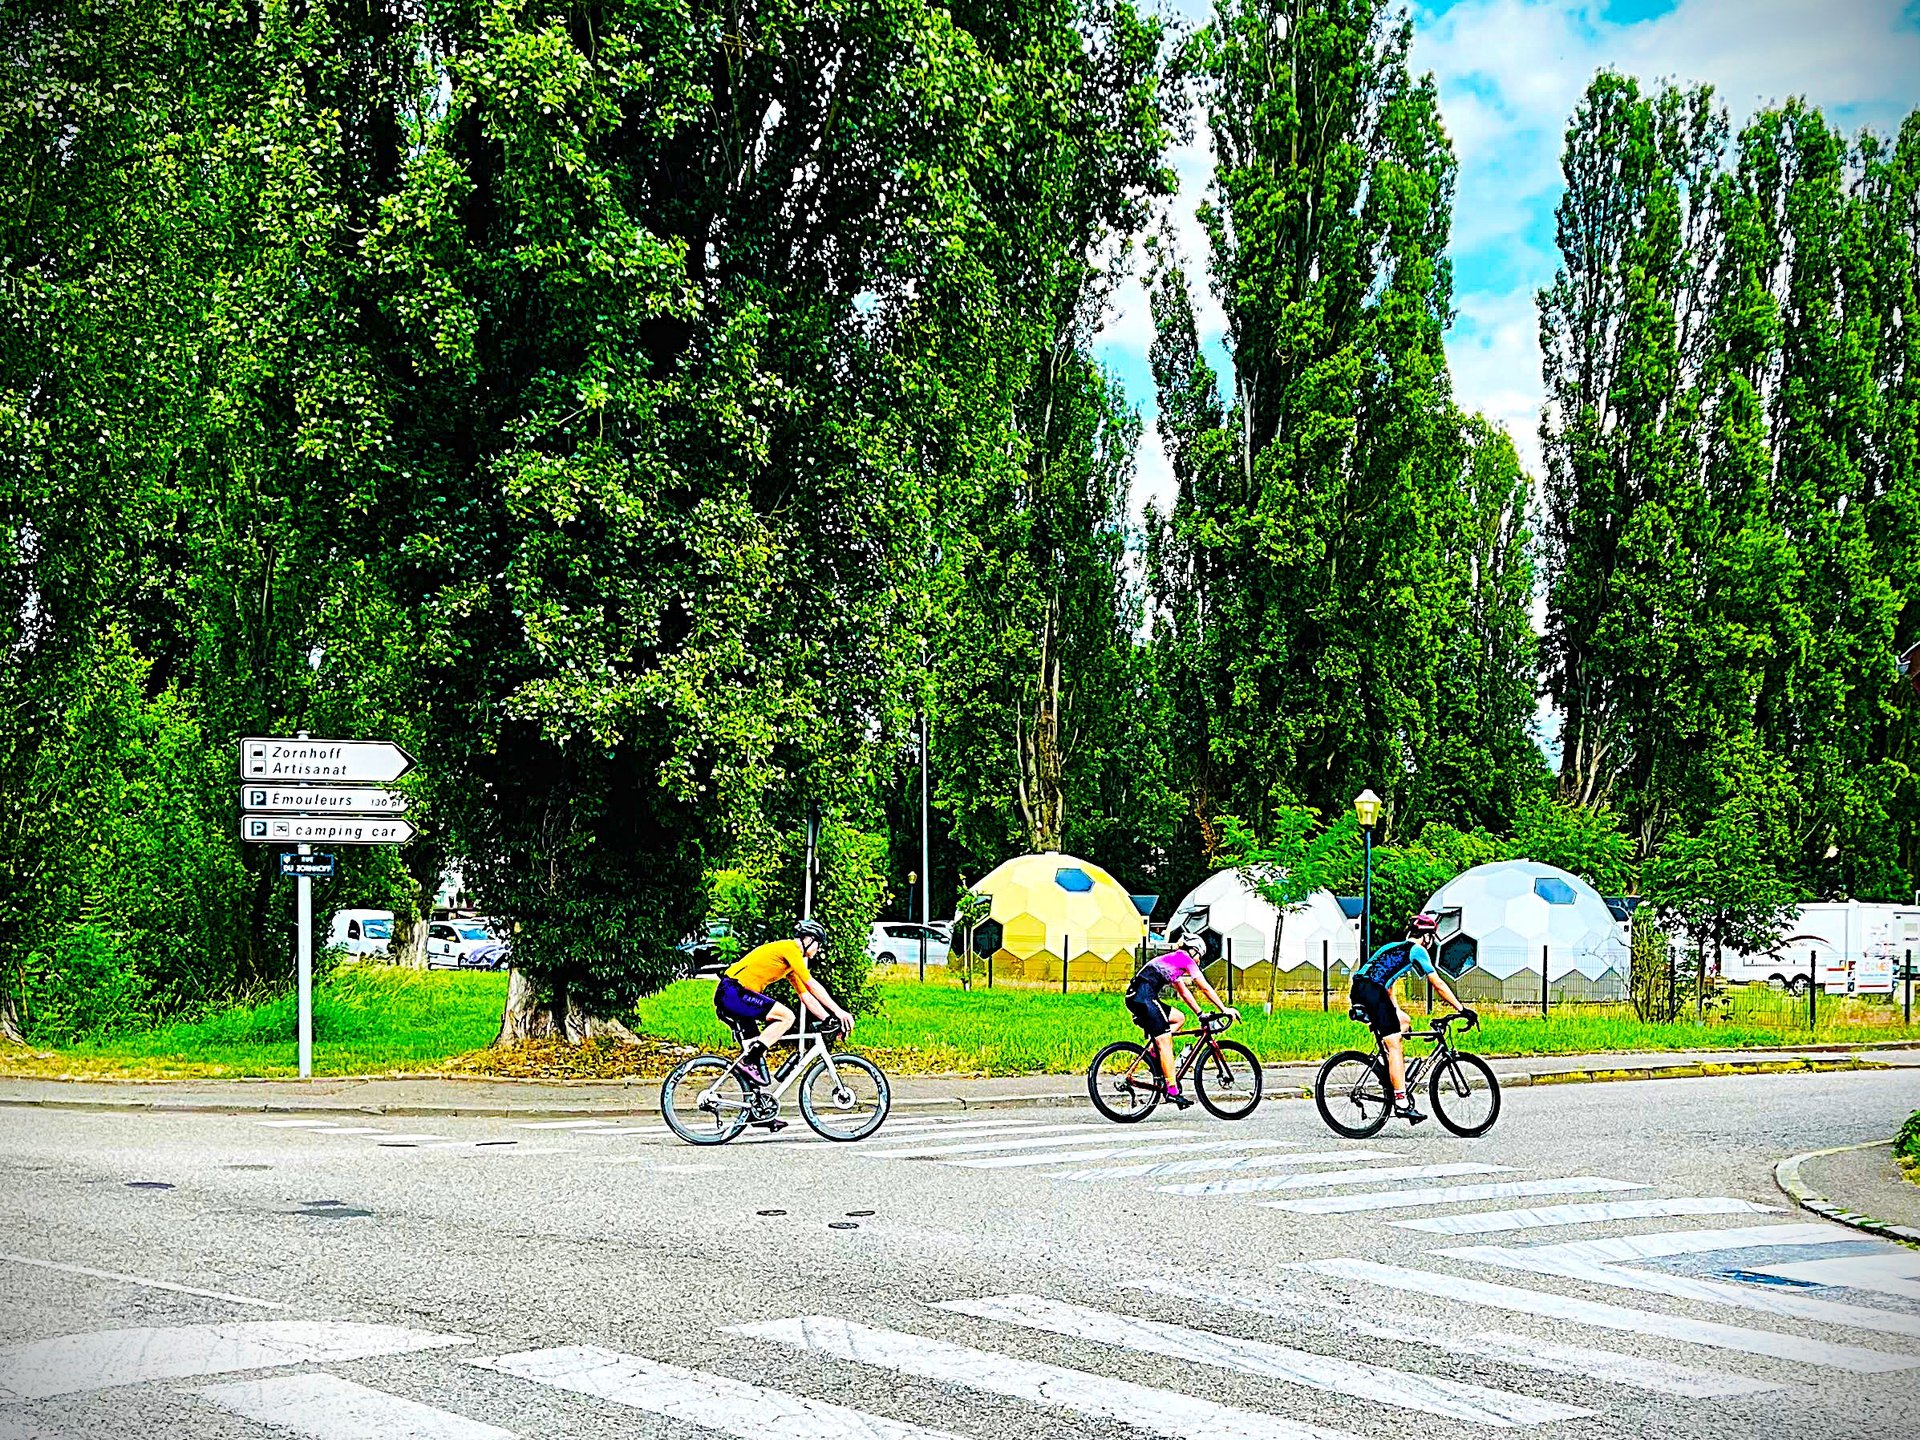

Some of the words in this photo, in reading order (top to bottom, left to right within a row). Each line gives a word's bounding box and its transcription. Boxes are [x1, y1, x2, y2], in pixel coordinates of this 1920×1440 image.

[272, 746, 342, 760] Zornhoff
[272, 762, 347, 776] Artisanat
[272, 790, 353, 807] Émouleurs
[371, 798, 388, 807] 130
[295, 825, 363, 839] camping
[371, 826, 397, 837] car
[283, 864, 294, 872] DU
